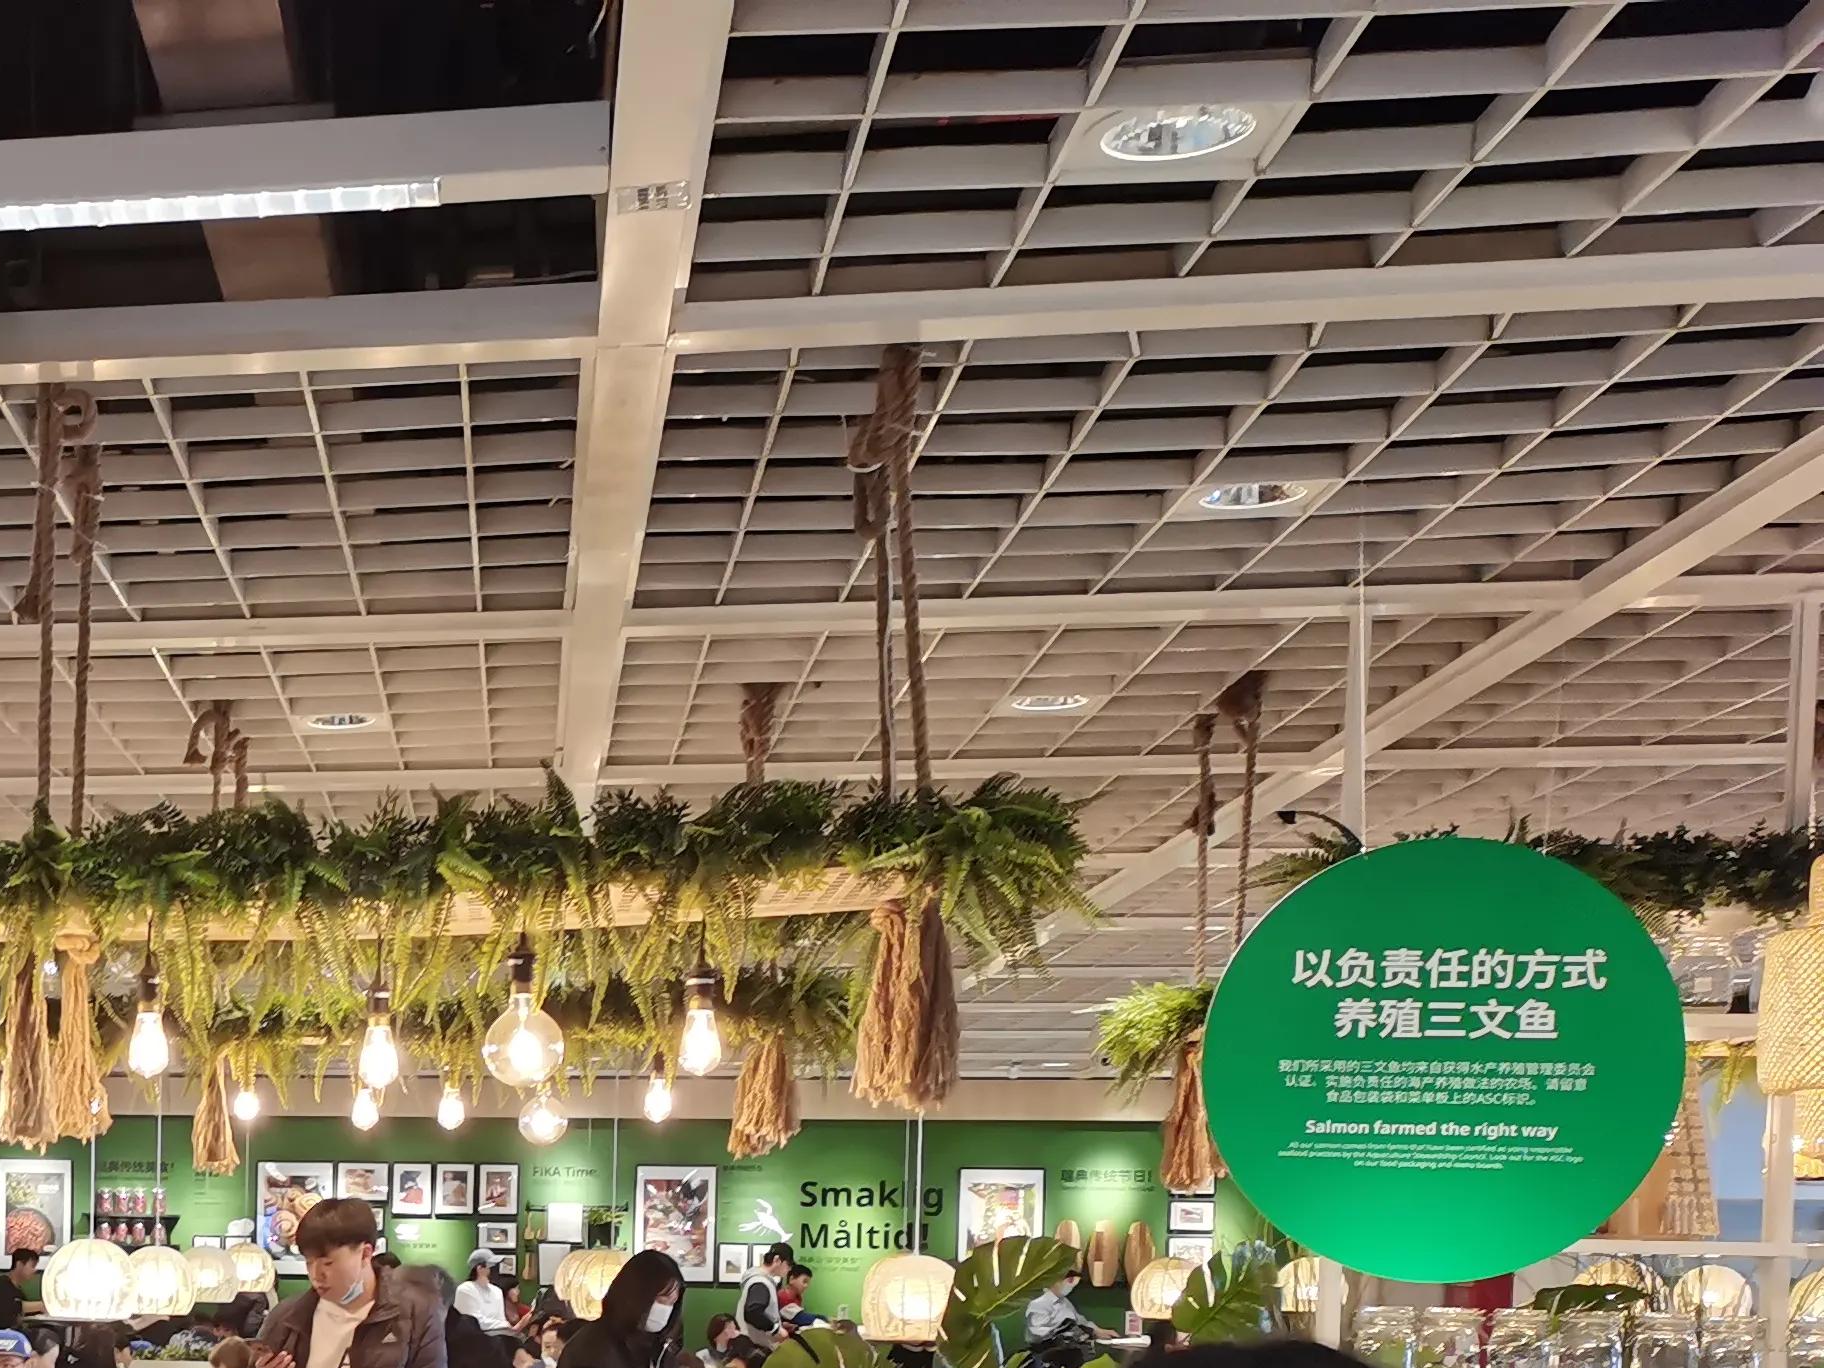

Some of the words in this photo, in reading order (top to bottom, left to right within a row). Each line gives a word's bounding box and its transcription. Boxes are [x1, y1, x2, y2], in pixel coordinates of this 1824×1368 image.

[1291, 947, 1608, 990] 以负责任的方式
[1334, 997, 1559, 1039] 养殖三文鱼
[1305, 1119, 1370, 1135] Salmon
[1373, 1119, 1438, 1136] farmed
[1440, 1121, 1472, 1137] the
[1474, 1122, 1519, 1141] right
[1520, 1126, 1559, 1142] way
[532, 1166, 561, 1177] FIKA
